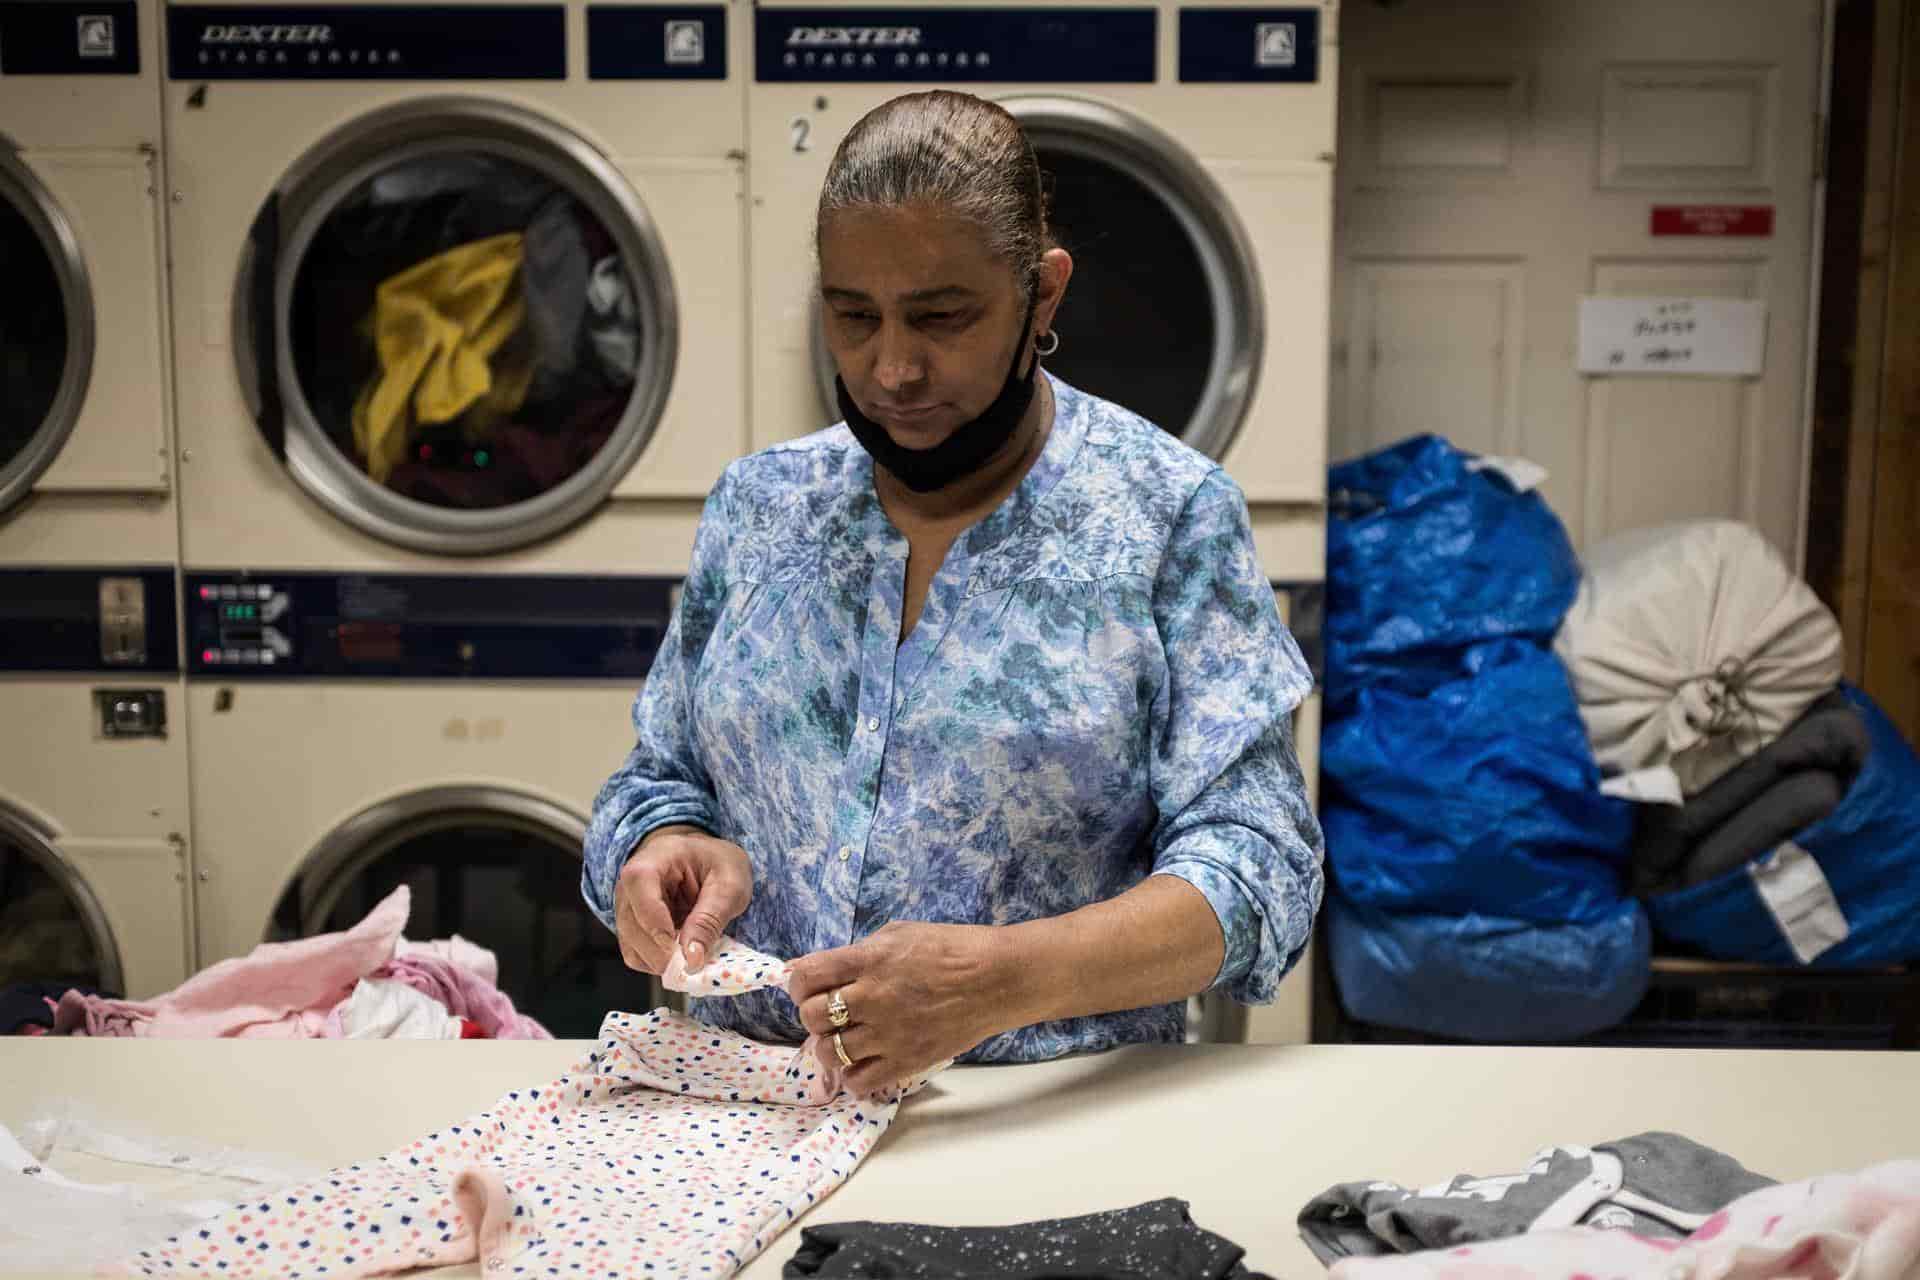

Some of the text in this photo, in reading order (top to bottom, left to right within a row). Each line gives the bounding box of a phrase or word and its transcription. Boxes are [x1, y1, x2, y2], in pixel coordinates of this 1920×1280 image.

[201, 25, 331, 42] DEXTER
[787, 27, 921, 44] DEXTER
[791, 117, 810, 153] 2
